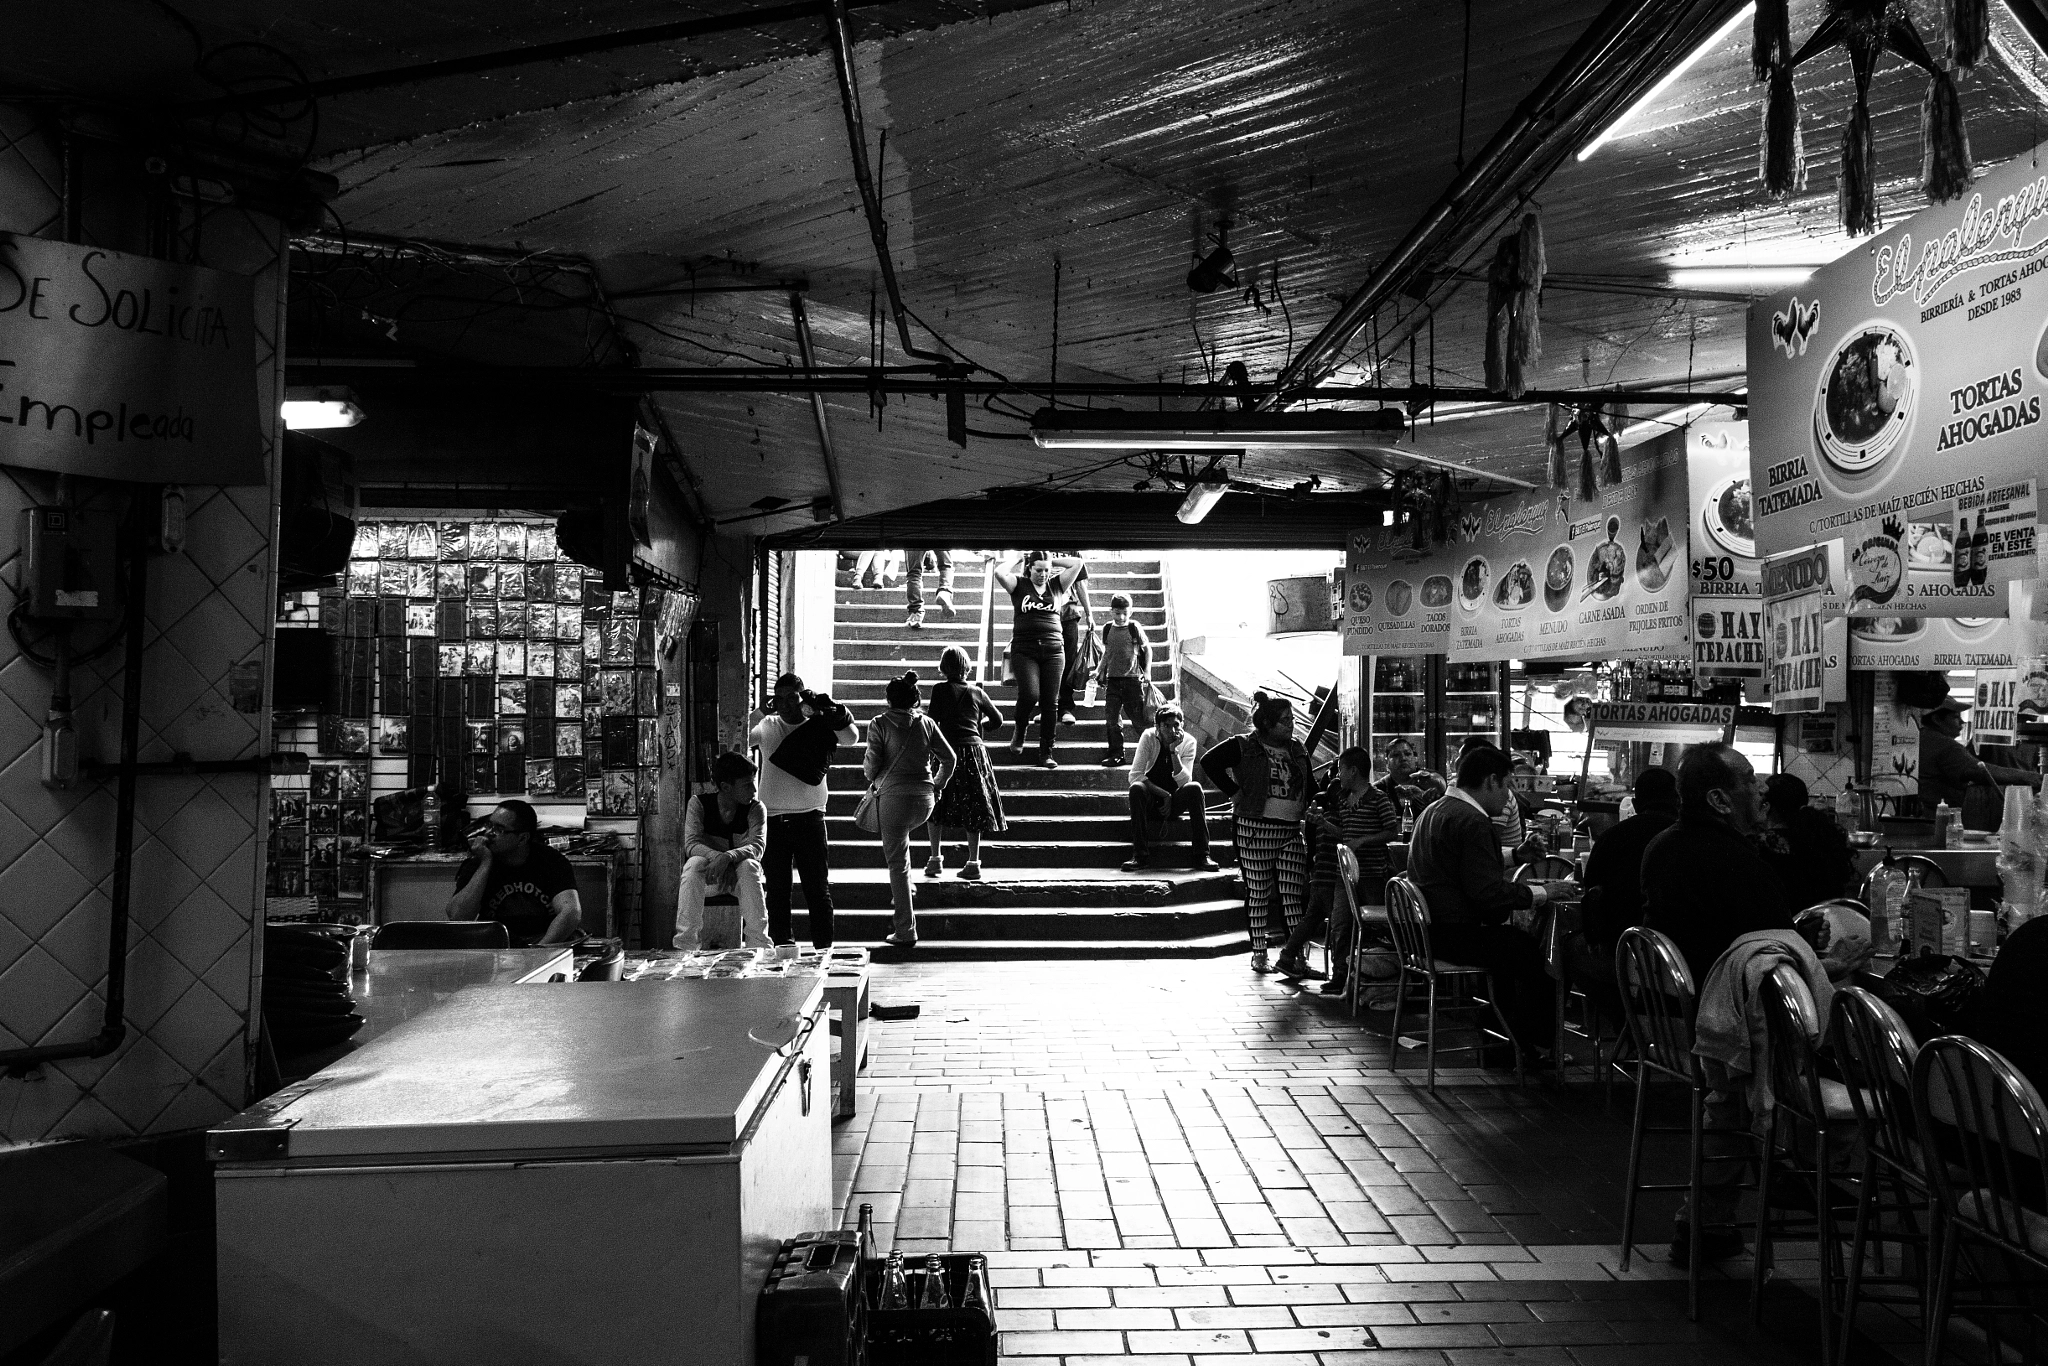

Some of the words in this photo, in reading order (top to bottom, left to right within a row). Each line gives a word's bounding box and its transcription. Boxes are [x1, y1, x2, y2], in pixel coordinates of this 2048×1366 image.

[1873, 234, 1912, 305] El
[1914, 176, 2048, 302] palenqu
[1920, 292, 1964, 323] BIRRIERÍA
[1968, 290, 1976, 303] &
[1979, 270, 2018, 298] TORTAS
[1967, 297, 1999, 321] DESDE
[2000, 287, 2022, 307] 1983
[1950, 367, 2023, 415] TORTAS
[1936, 396, 2041, 452] AHOGADAS
[1768, 455, 1808, 487] BIRRIA
[1758, 479, 1822, 517] TATEMADA
[1809, 508, 1863, 535] C/TORTILLAS
[1864, 503, 1877, 518] DE
[1878, 495, 1901, 516] MAÍZ
[1902, 486, 1939, 510] RECIÉN
[1940, 476, 1985, 501] HECHAS
[1958, 494, 1985, 510] BEBIDA
[1986, 483, 2030, 504] ARTESANAL
[1990, 532, 2001, 543] DE
[2004, 526, 2036, 541] VENTA
[1988, 549, 2036, 561] ESTABLECIMIENTO
[1992, 542, 2005, 553] EN
[2007, 538, 2032, 551] ESTE
[1692, 556, 1734, 580] $50
[1762, 553, 1827, 597] MENUDO
[1699, 582, 1750, 594] BIRRIA
[1919, 584, 1994, 597] AHOGADAS
[1579, 609, 1601, 624] CARNE
[1602, 605, 1626, 620] ASADA
[1635, 602, 1658, 615] ORDEN
[1659, 600, 1669, 612] DE
[1894, 602, 1928, 610] HECHAS
[1350, 615, 1370, 626] QUESO
[1377, 620, 1416, 632] QUESADILLAS
[1426, 612, 1447, 622] TACOS
[1628, 618, 1658, 634] FRIJOLES
[1658, 615, 1684, 628] FRITOS
[1720, 611, 1761, 639] HAY
[1346, 626, 1374, 636] FUNDIDO
[1420, 622, 1451, 633] DORADOS
[1539, 619, 1569, 635] MENUDO
[1790, 612, 1820, 656] HAY
[1696, 642, 1764, 662] TEPACHE
[1877, 654, 1920, 666] AHOGADAS
[1933, 653, 1962, 665] BIRRIA
[1964, 653, 2014, 666] TATEMADA
[1774, 657, 1821, 693] TEPACHE
[1989, 681, 2016, 707] HAY
[1590, 704, 1647, 721] TORTAS
[1648, 704, 1732, 723] AHOGADAS
[1974, 710, 2015, 730] TEPACHE
